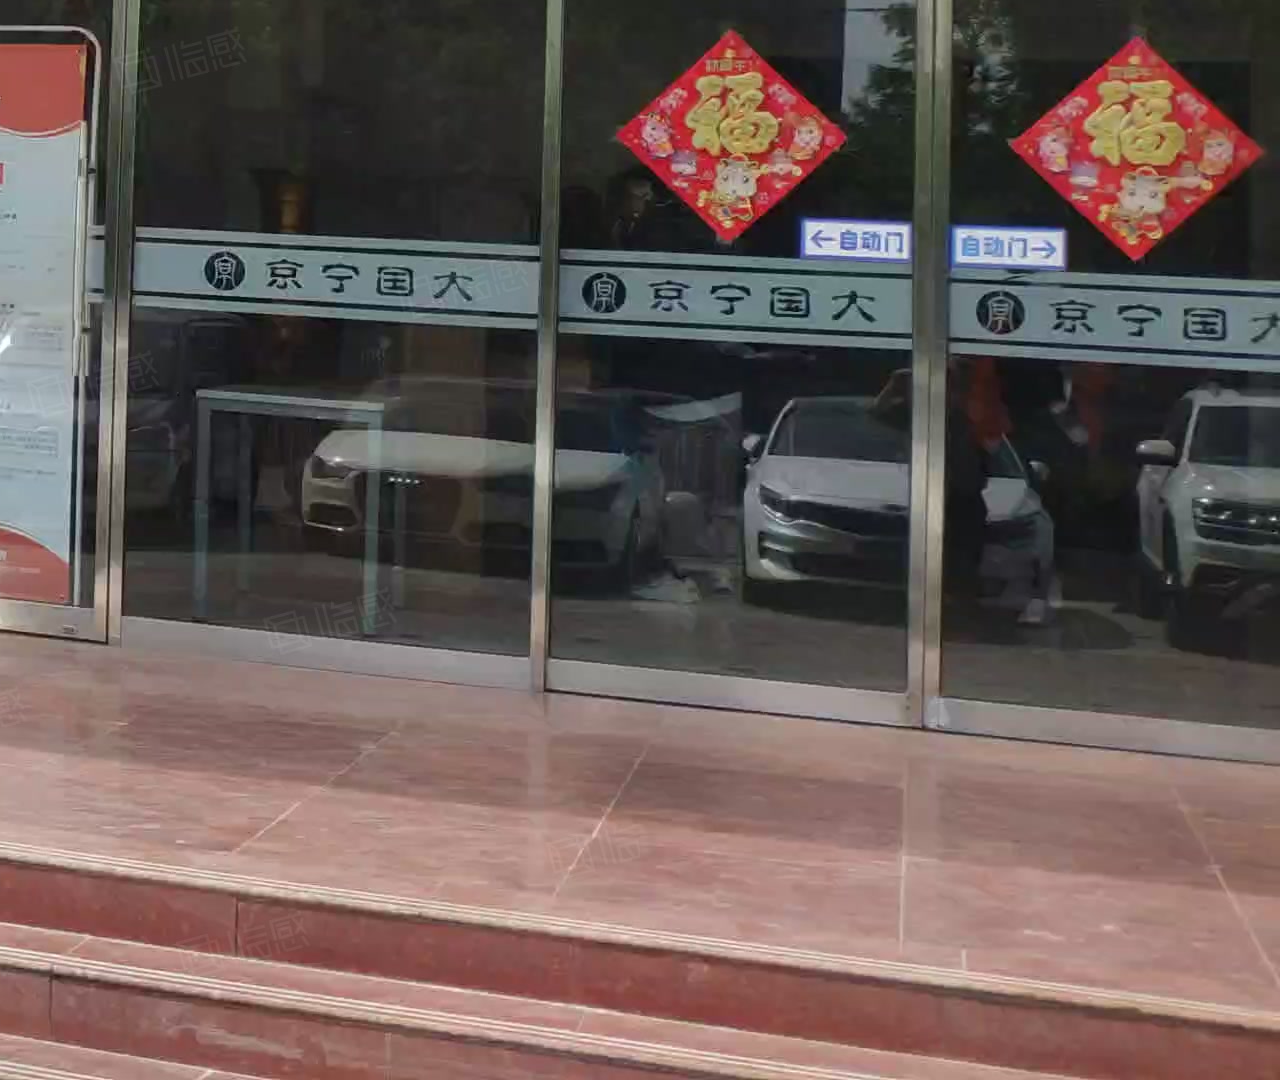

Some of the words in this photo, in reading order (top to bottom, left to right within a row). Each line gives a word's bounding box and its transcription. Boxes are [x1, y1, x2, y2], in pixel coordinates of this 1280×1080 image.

[840, 230, 904, 253] 自动门
[962, 235, 1028, 258] 自动门
